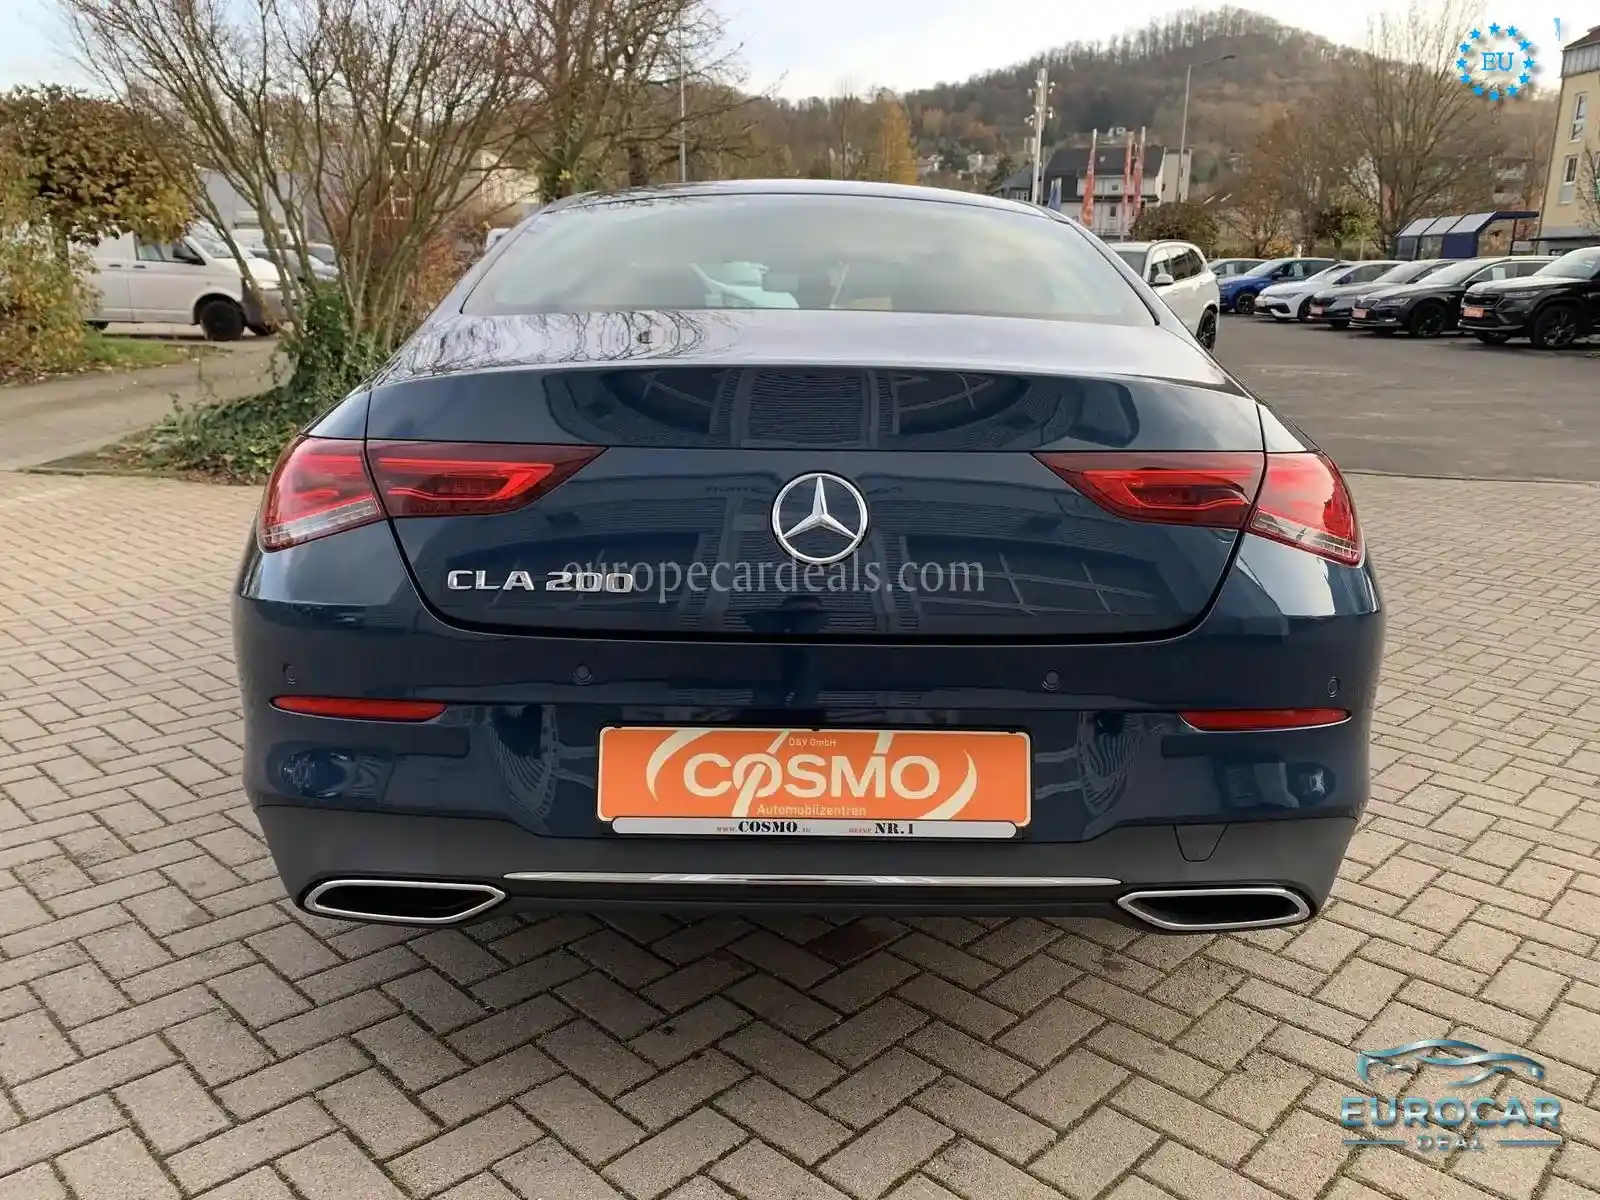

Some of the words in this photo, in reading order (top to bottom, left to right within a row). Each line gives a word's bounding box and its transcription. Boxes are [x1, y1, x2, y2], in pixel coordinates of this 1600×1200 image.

[447, 570, 535, 591] CLA
[545, 571, 633, 593] 200
[683, 753, 941, 799] COSMO
[757, 804, 867, 816] Automobilzentren
